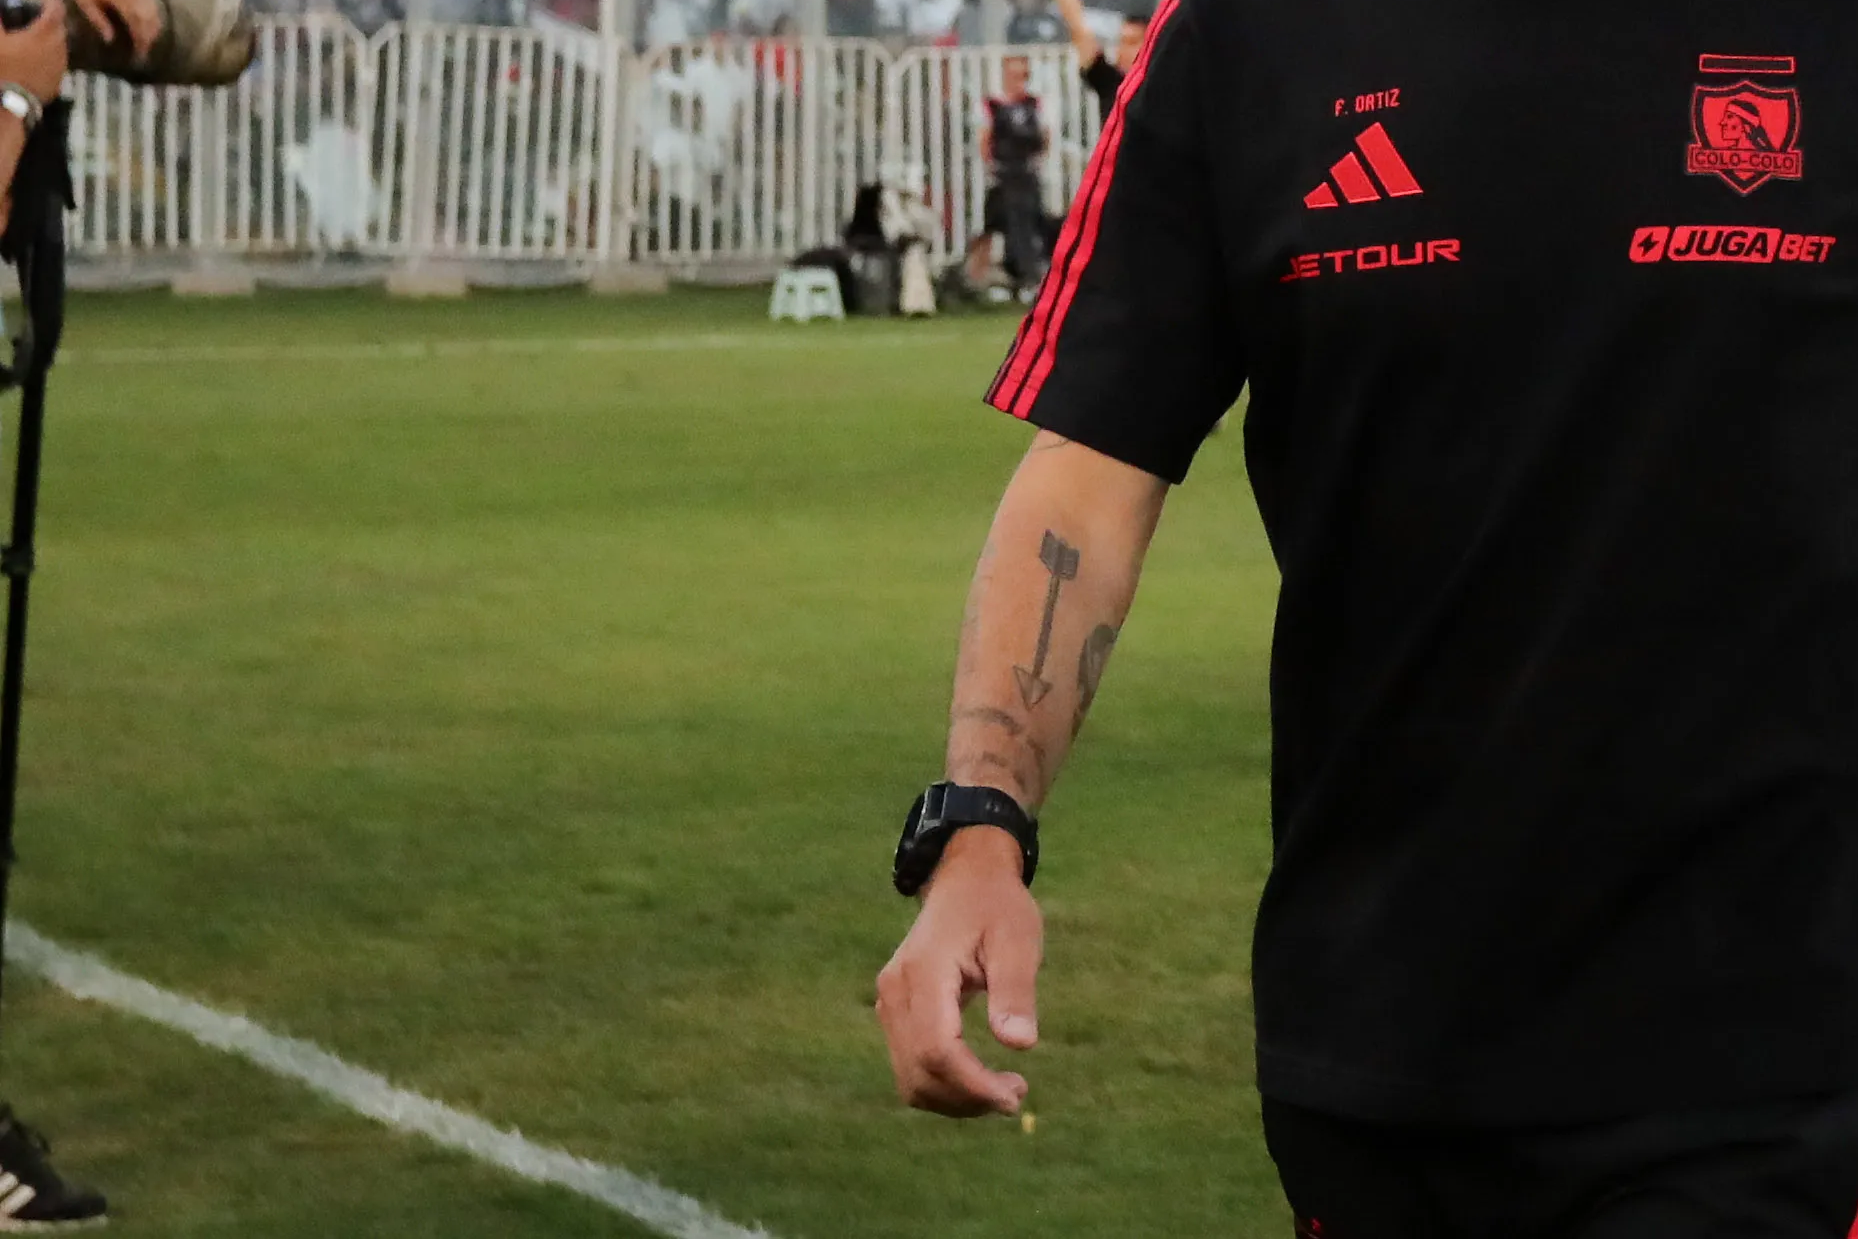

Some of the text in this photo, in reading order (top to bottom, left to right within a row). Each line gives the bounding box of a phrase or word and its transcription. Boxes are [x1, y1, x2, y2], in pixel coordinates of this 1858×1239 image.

[1334, 87, 1401, 117] F. ORTIZ
[1694, 151, 1794, 172] COLO-COLO
